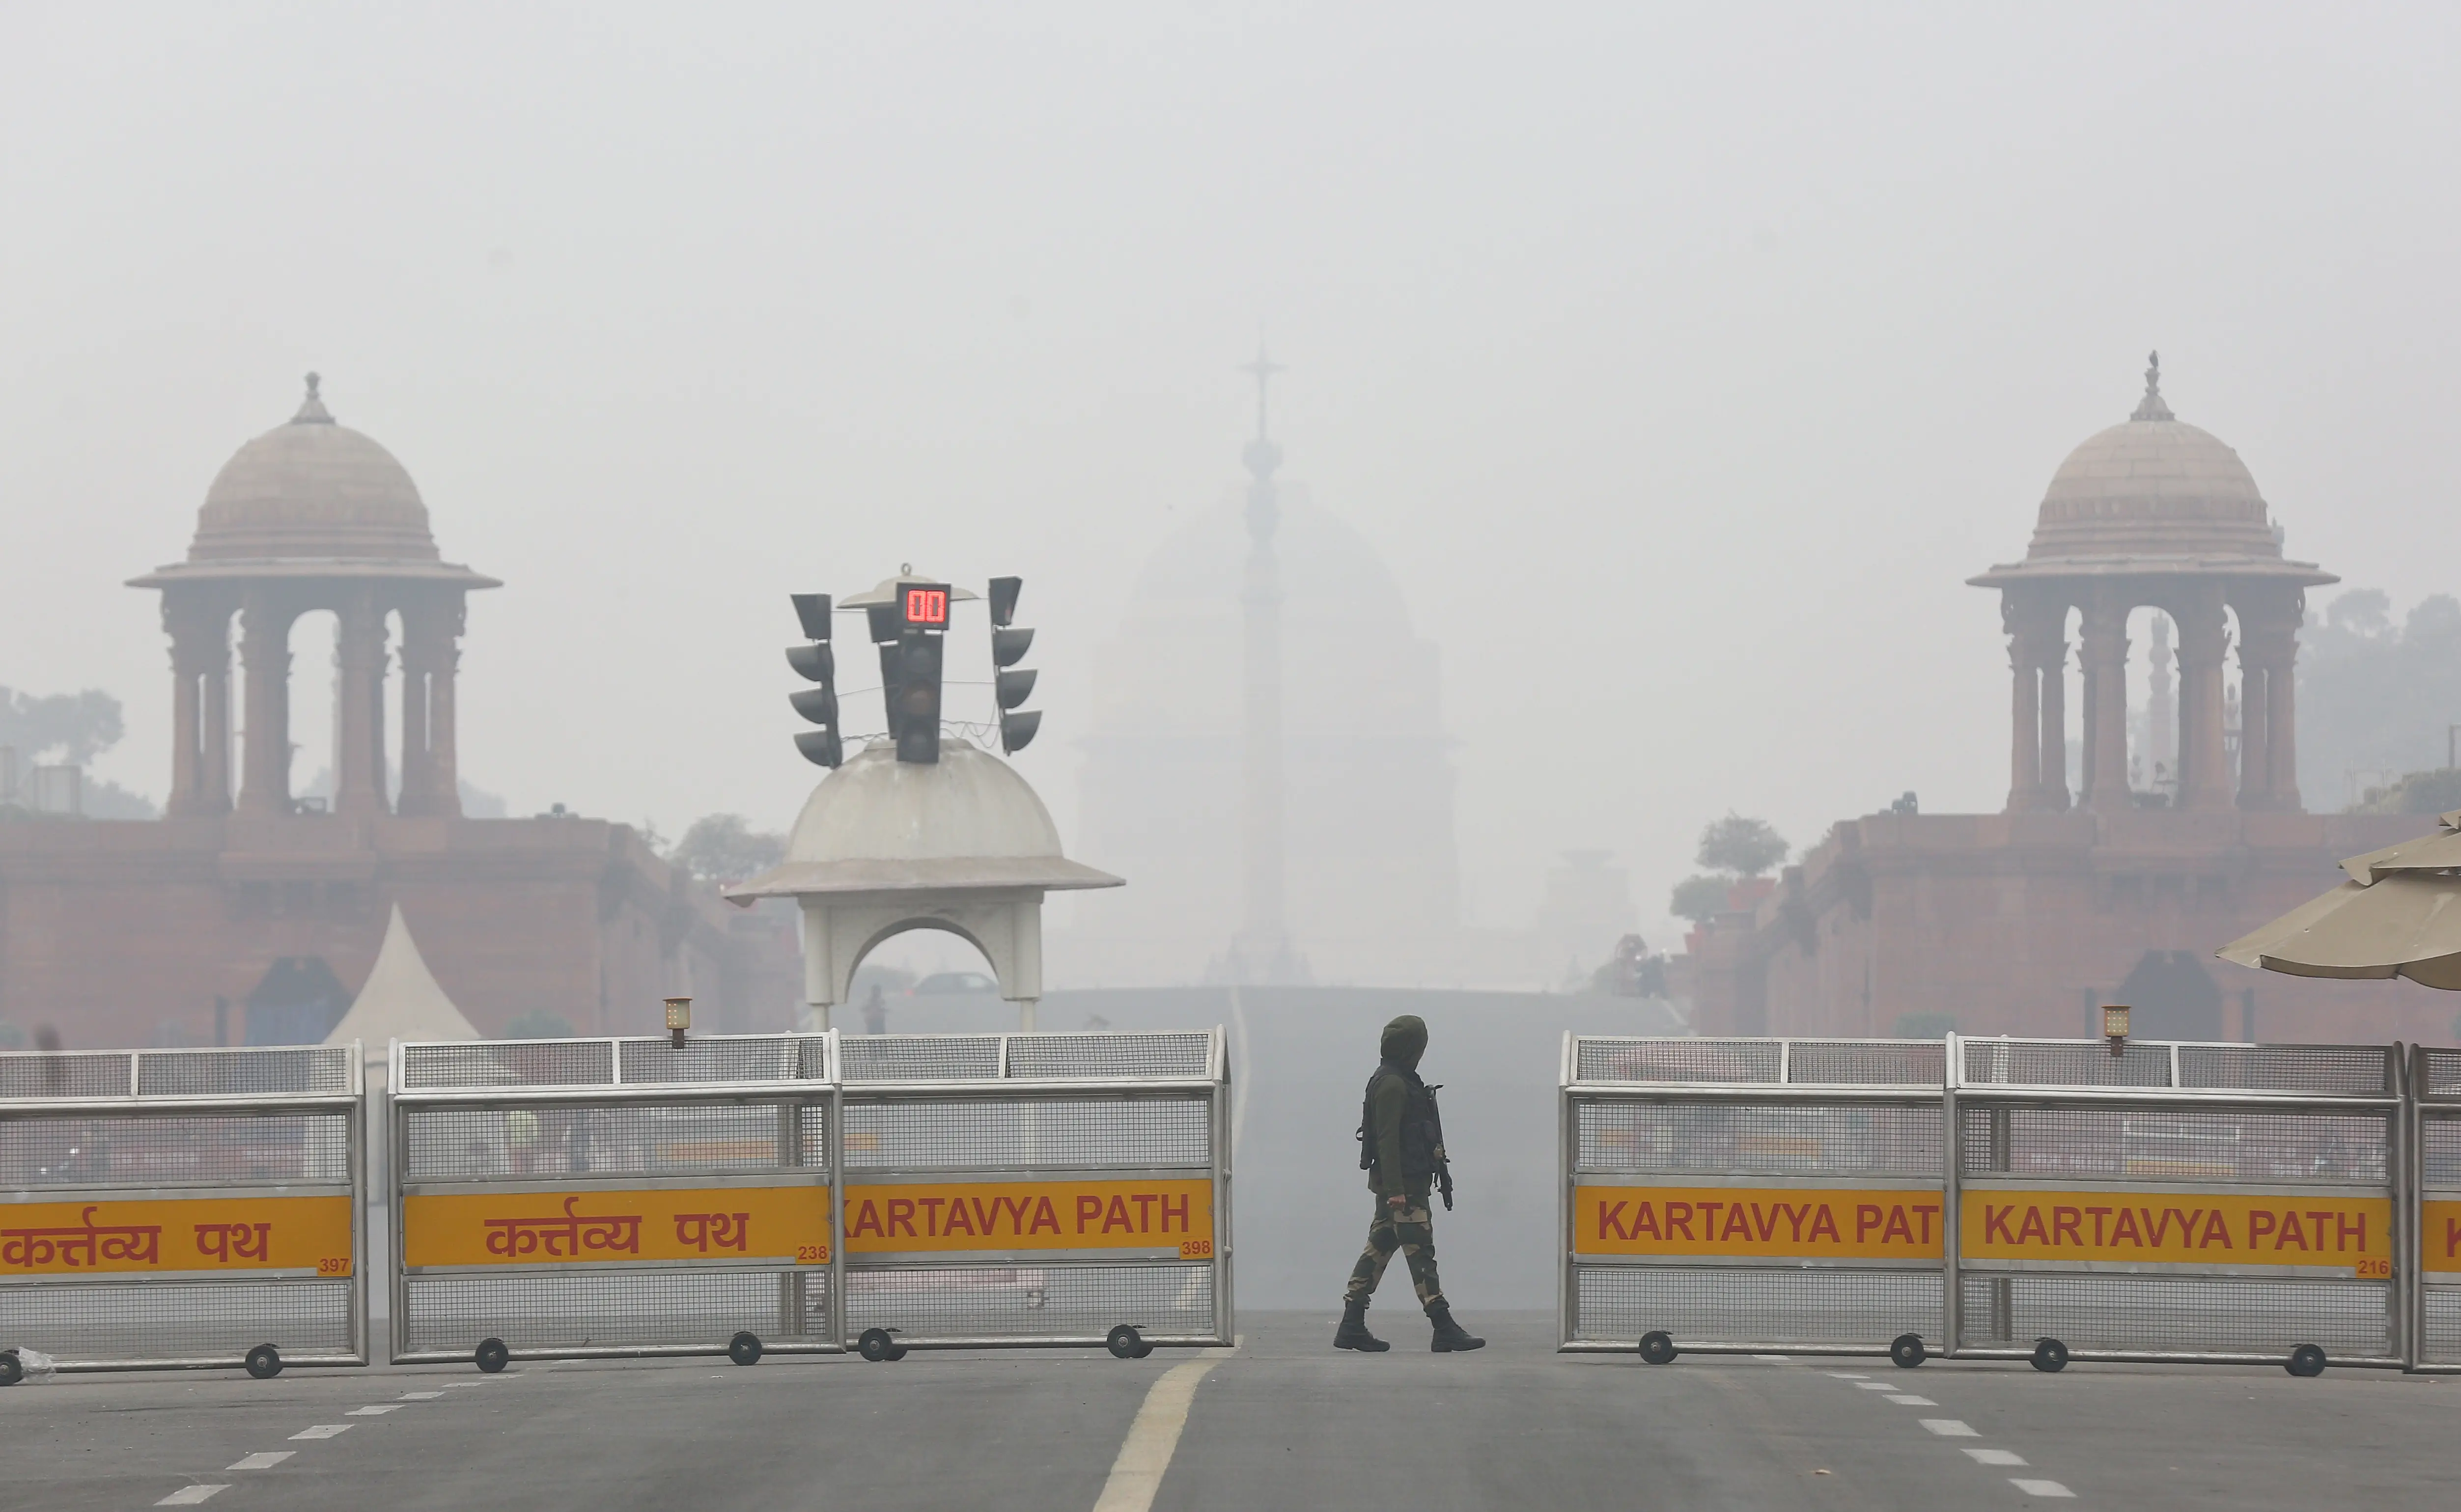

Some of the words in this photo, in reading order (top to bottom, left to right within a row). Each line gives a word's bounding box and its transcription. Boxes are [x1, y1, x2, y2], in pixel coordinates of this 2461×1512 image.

[907, 590, 946, 622] 00
[673, 1212, 750, 1253] पथ
[844, 1196, 1062, 1238] ARTAVYA
[1076, 1194, 1189, 1234] PATH
[1599, 1201, 1841, 1243] KARTAVYA
[1856, 1204, 1940, 1244] PAT
[1985, 1204, 2233, 1249] KARTAVYA
[2249, 1210, 2366, 1252] PATH
[194, 1223, 271, 1262] पथ
[798, 1245, 828, 1260] 238
[1182, 1240, 1211, 1255] 398
[319, 1258, 349, 1273] 397
[2358, 1260, 2389, 1275] 216
